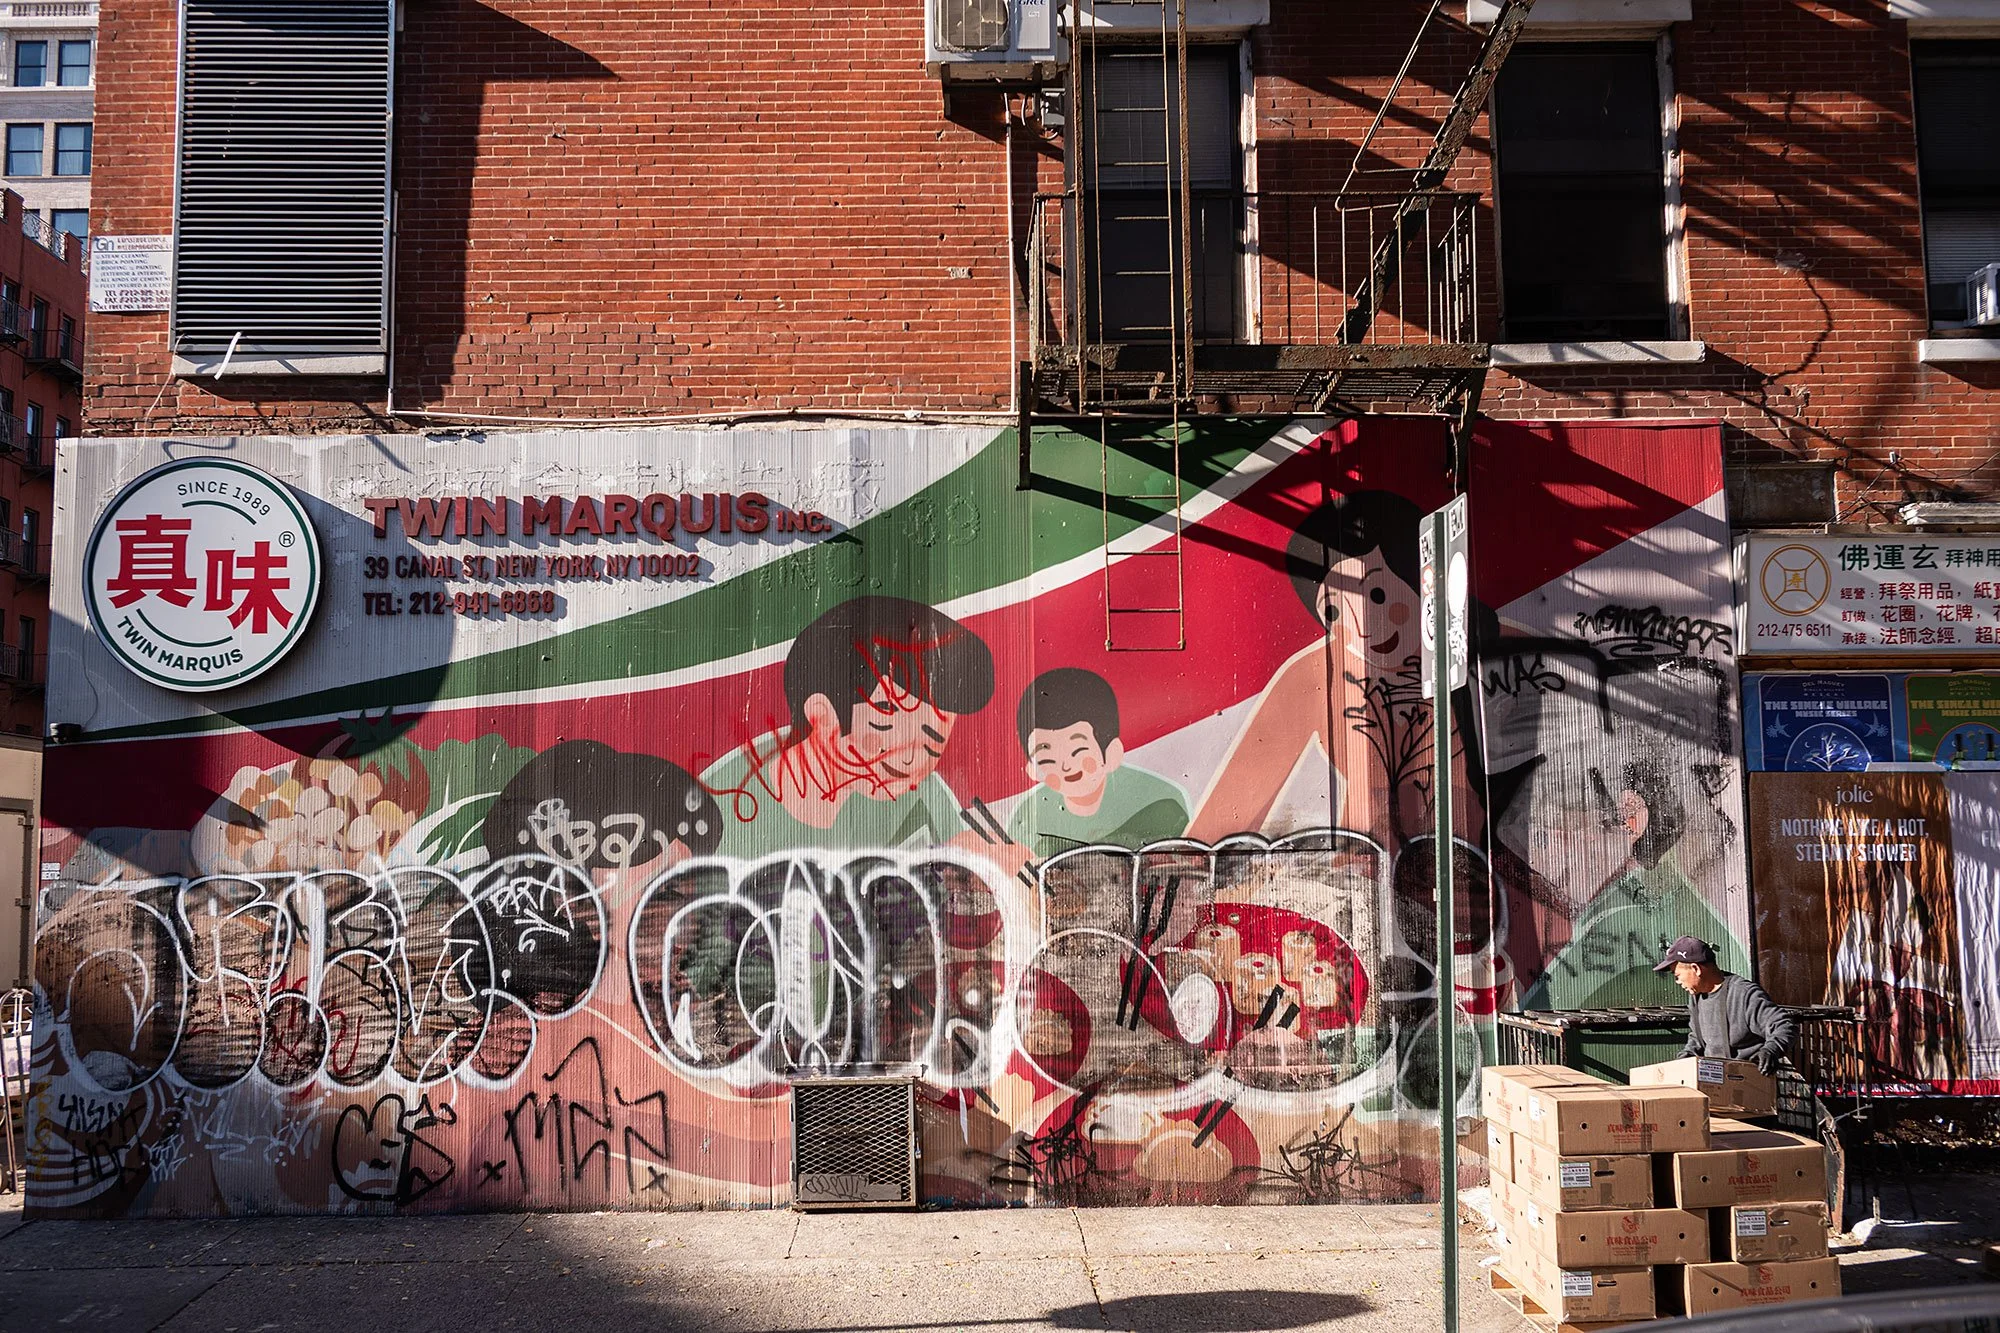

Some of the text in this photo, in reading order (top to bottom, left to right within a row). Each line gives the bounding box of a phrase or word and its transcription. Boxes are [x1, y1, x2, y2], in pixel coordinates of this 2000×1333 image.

[177, 480, 271, 517] SINCE 1989
[364, 491, 832, 542] TWIN MARQUIS INC.
[364, 553, 700, 581] 39 CANAL ST, NEW YORK, NY 10002
[1837, 543, 1940, 572] 佛運玄
[106, 514, 294, 634] 真味
[363, 590, 555, 616] TEL: 212-941-6868
[1805, 623, 1832, 637] 6511
[117, 615, 244, 674] TWIN MARQUIS
[1764, 701, 1888, 710] THE SINGLE VILLAGE
[1910, 700, 1935, 710] THE
[1936, 700, 1981, 710] SINGLE
[1835, 784, 1874, 807] jolie
[1781, 819, 1930, 839] NOTHING LIKE A HOT,
[1796, 844, 1918, 862] STEAMY SHOWER
